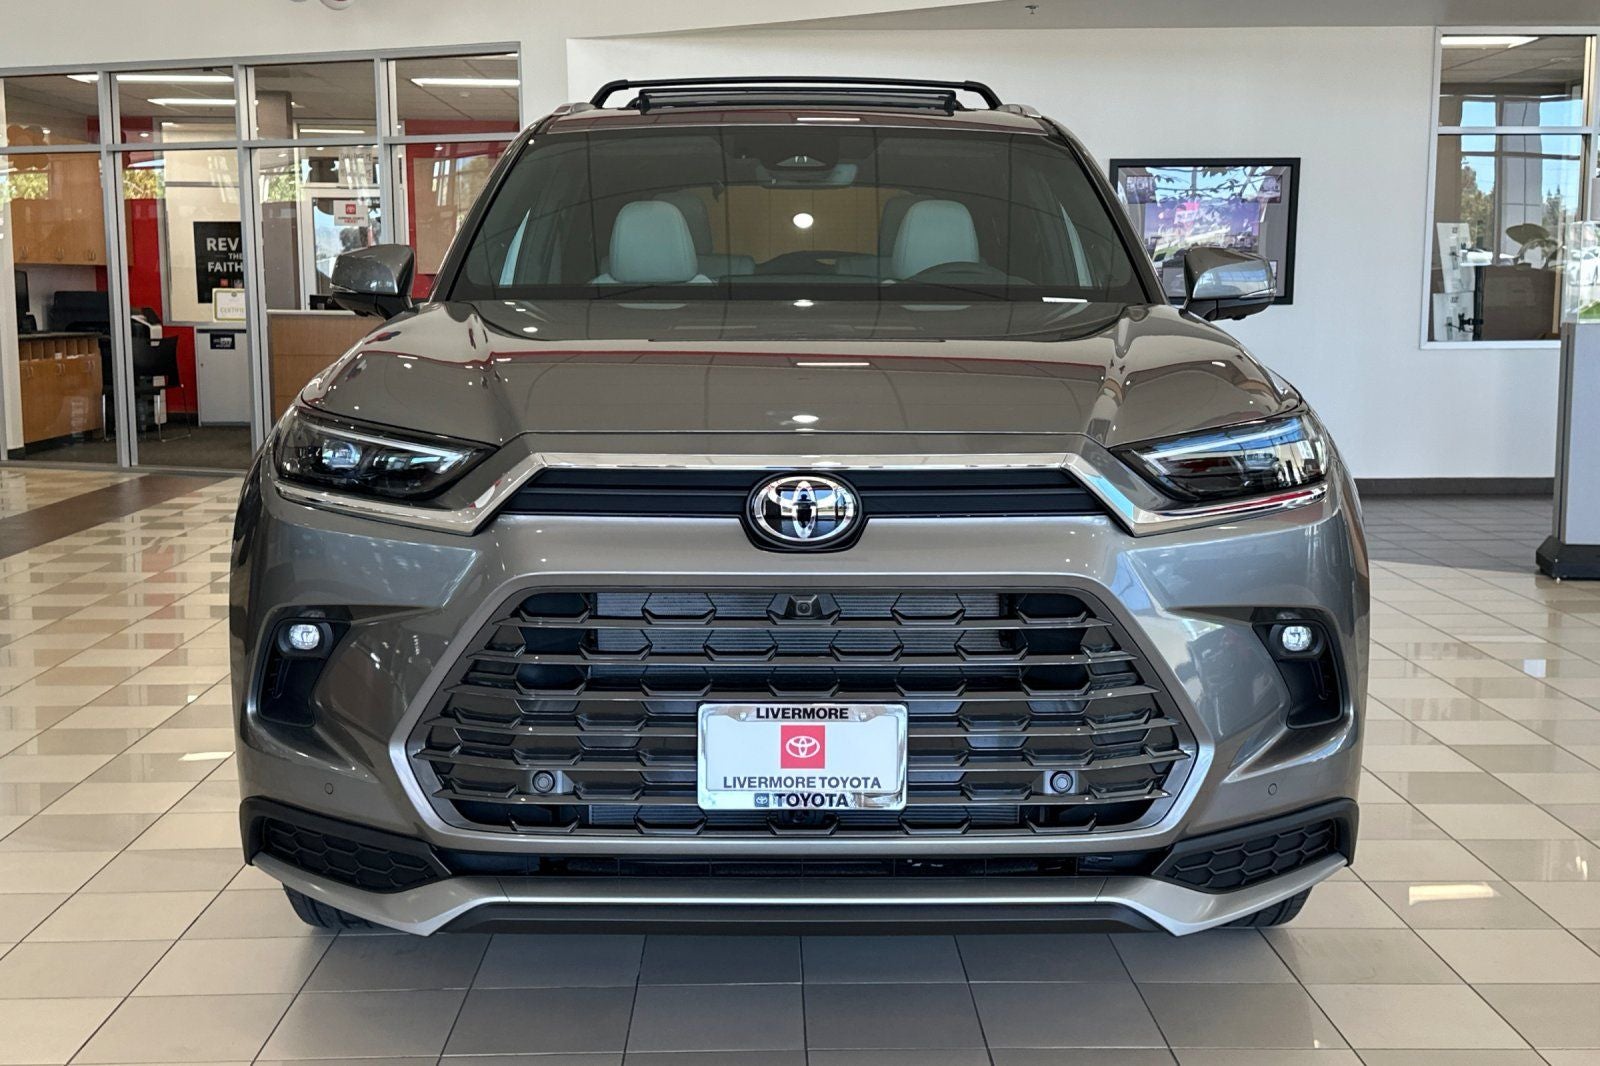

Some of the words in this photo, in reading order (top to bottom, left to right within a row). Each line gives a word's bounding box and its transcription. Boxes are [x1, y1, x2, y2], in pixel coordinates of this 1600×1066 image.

[206, 237, 239, 251] REV
[756, 707, 849, 719] LIVERMORE
[723, 776, 817, 789] LIVERMORE
[819, 776, 881, 789] TOYOTA
[775, 793, 849, 807] TOYOTA
